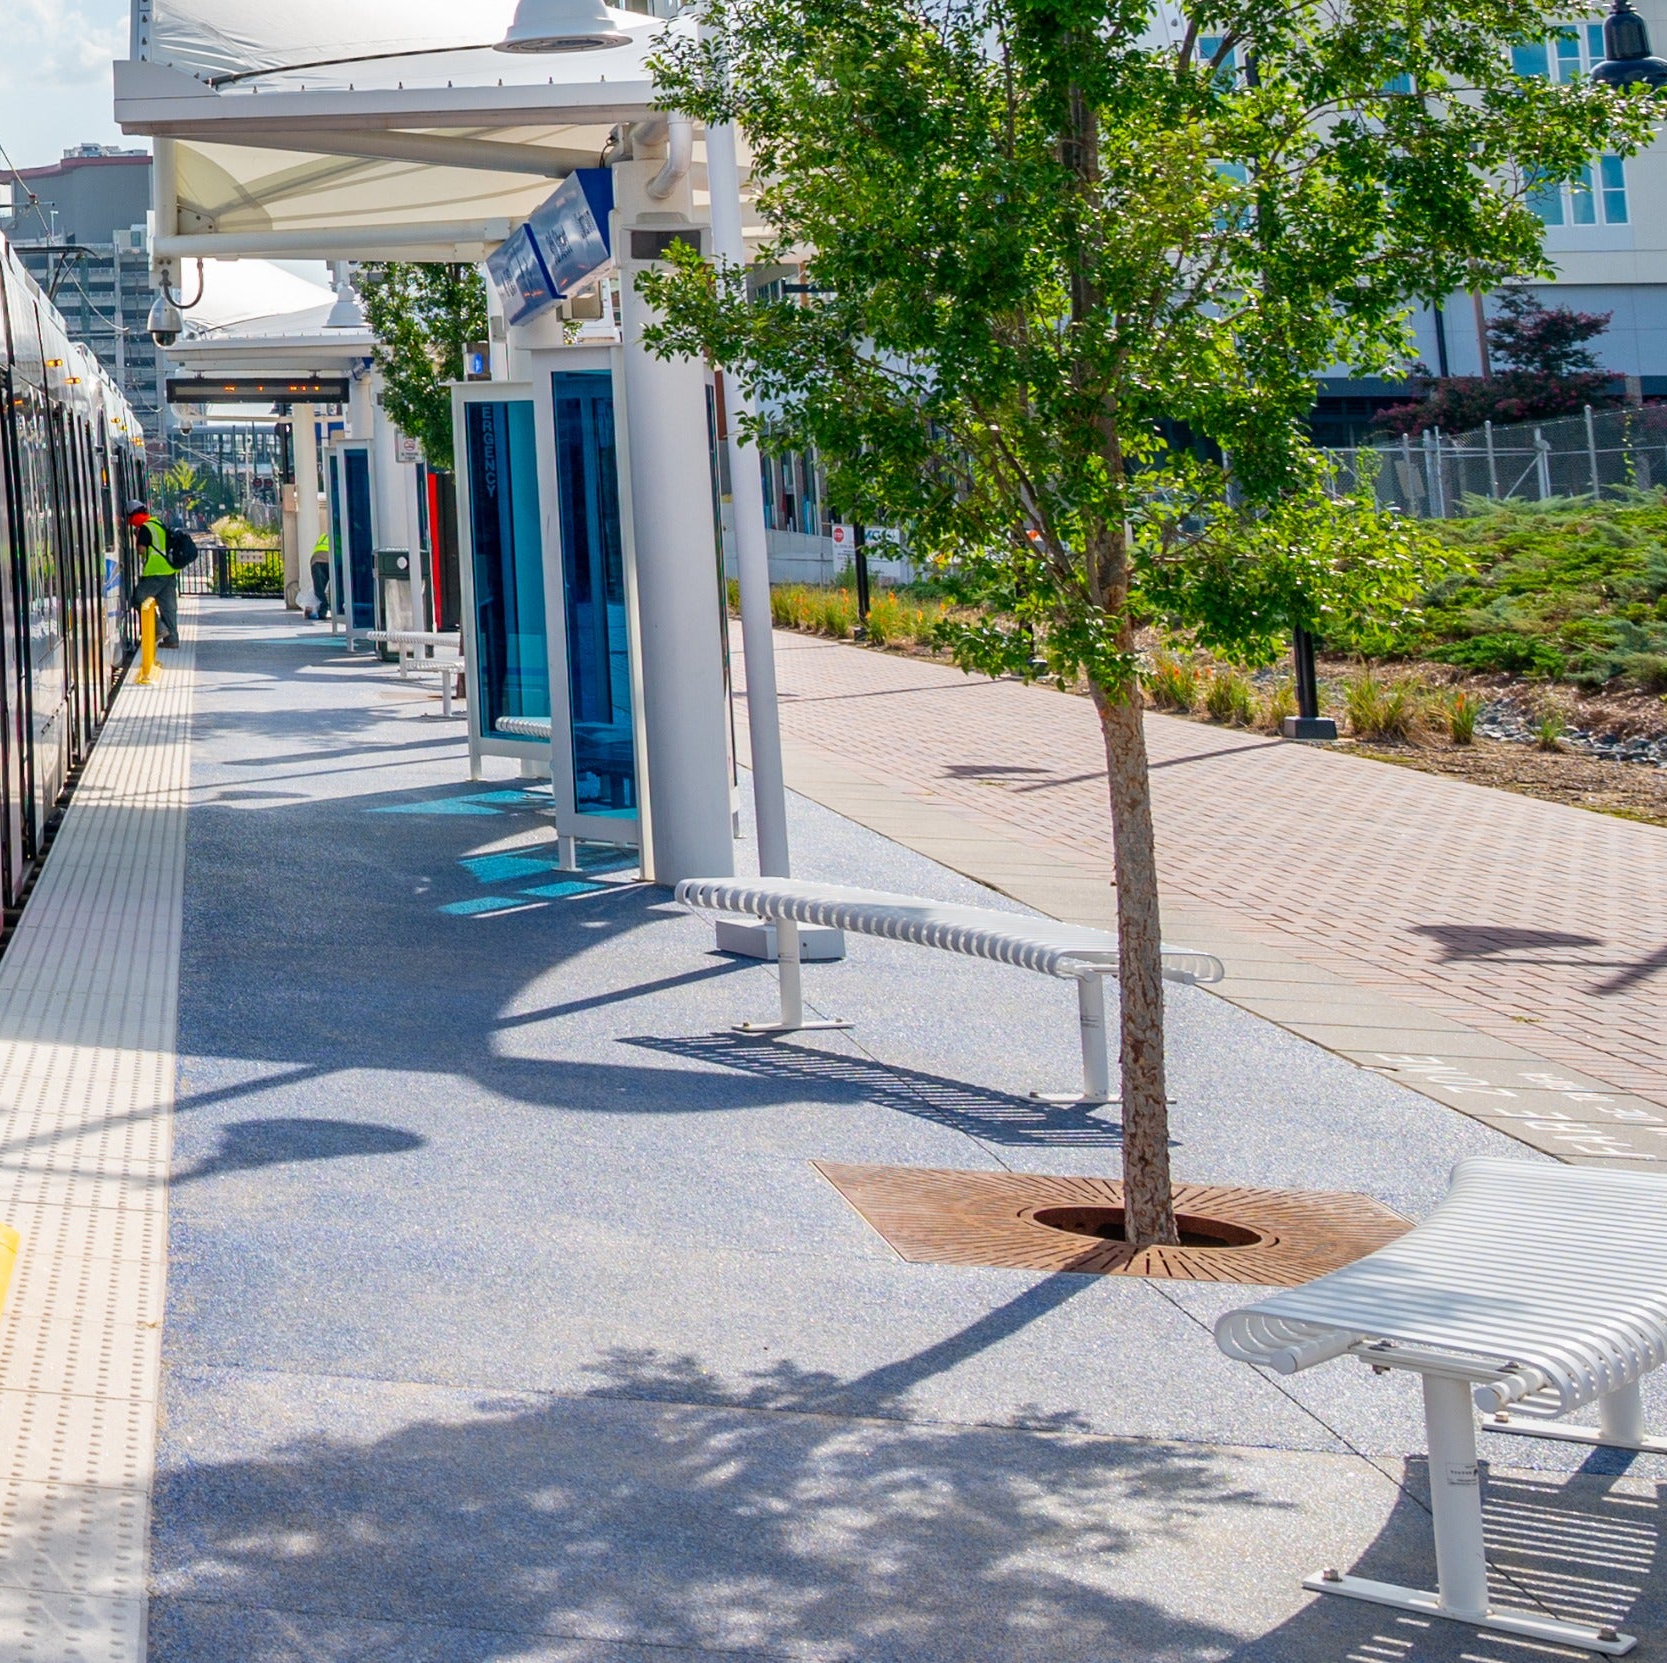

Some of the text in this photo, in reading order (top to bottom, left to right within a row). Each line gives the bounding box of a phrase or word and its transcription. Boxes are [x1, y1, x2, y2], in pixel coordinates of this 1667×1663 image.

[481, 405, 497, 498] ERGENCY
[1374, 1053, 1657, 1160] FARE ZONE
